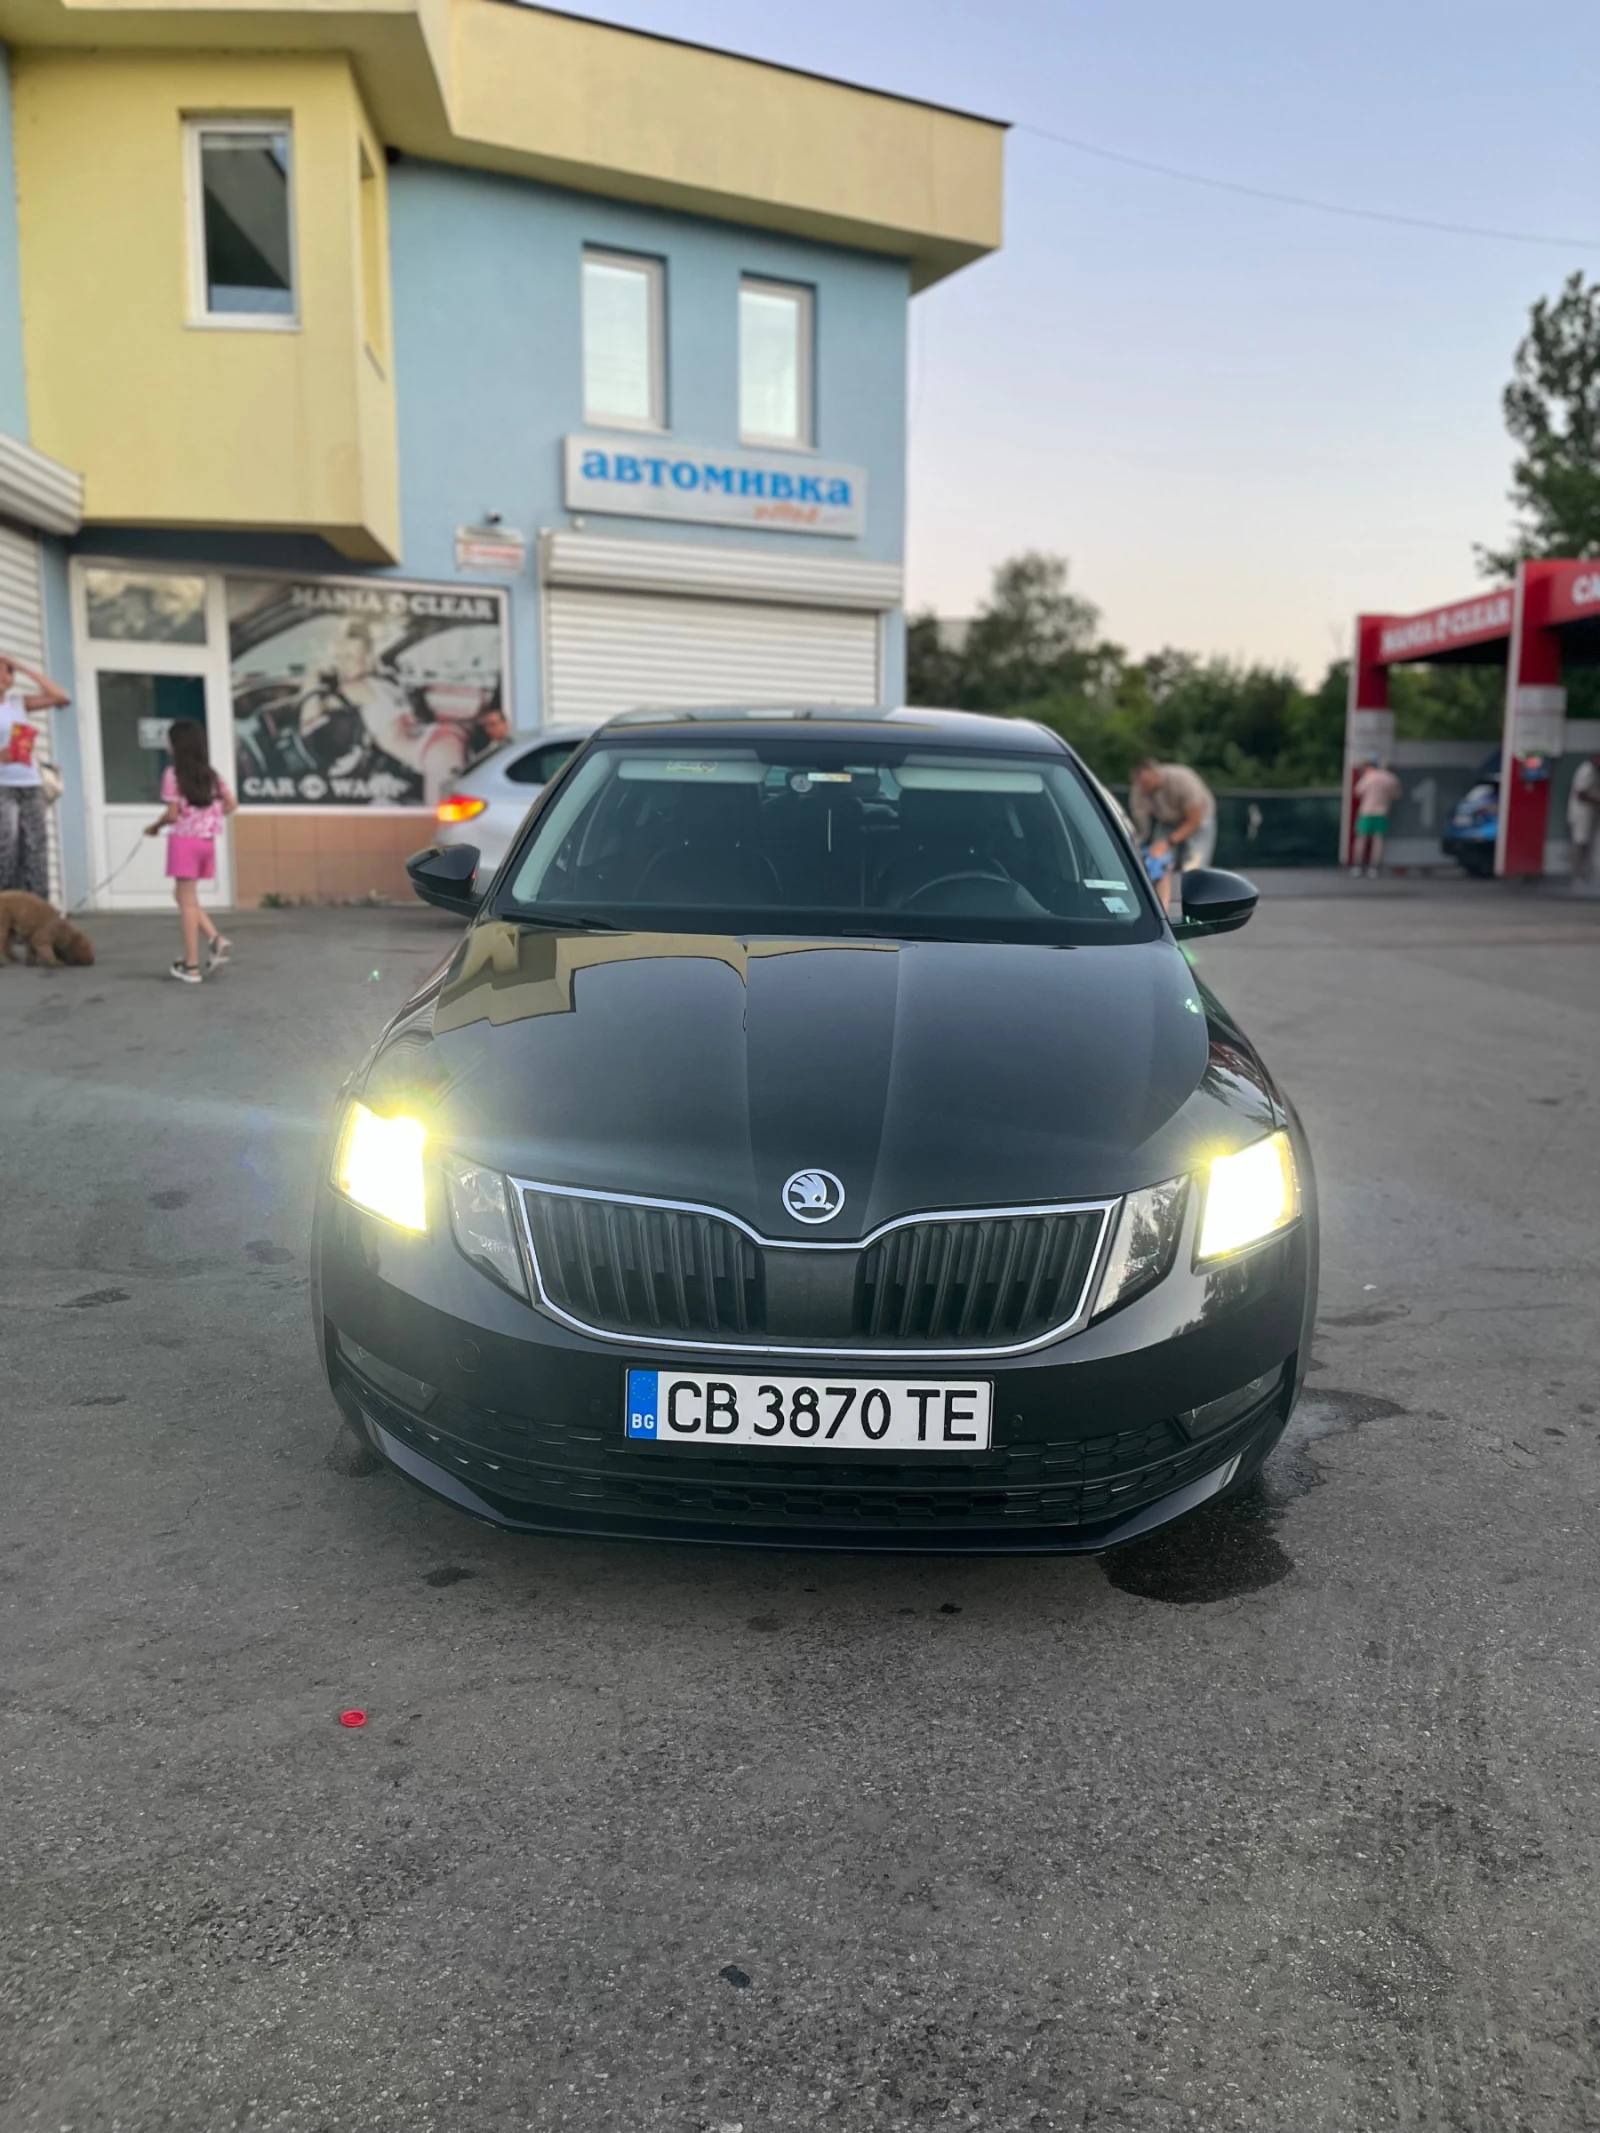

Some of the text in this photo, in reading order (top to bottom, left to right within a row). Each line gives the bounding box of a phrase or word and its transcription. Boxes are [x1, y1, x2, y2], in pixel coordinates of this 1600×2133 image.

[291, 585, 494, 620] MANIA CLEAR
[242, 775, 296, 798] CAR
[631, 1413, 655, 1430] BG
[667, 1380, 978, 1442] CB 3870 TE
